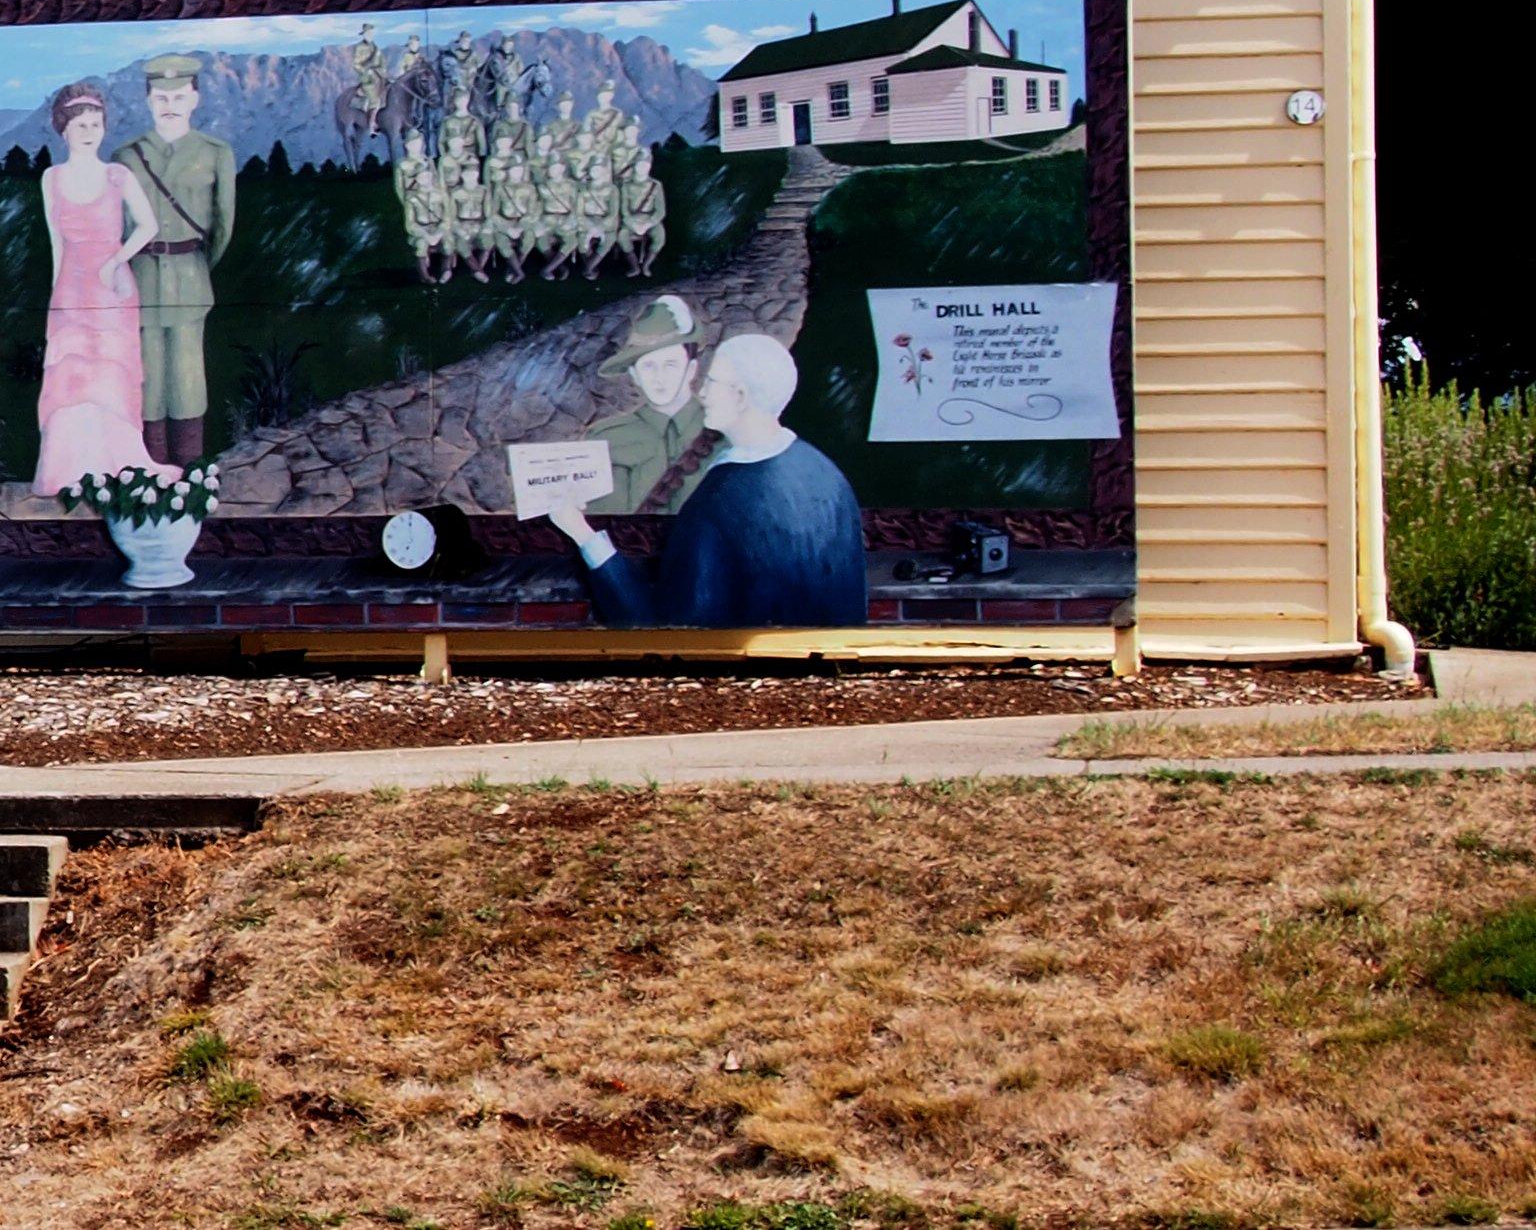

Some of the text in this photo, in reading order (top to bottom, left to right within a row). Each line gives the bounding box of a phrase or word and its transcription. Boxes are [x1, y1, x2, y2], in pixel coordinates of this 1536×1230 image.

[1291, 97, 1315, 114] 14
[911, 297, 1041, 319] The DRILL HALL
[954, 325, 974, 337] This
[979, 324, 1011, 336] mural
[1013, 324, 1050, 336] depicts
[954, 335, 1056, 349] retired member of the
[982, 349, 1007, 360] Horse
[1050, 350, 1063, 359] as
[952, 377, 980, 391] front
[983, 376, 995, 389] of
[527, 474, 569, 487] MILITARY
